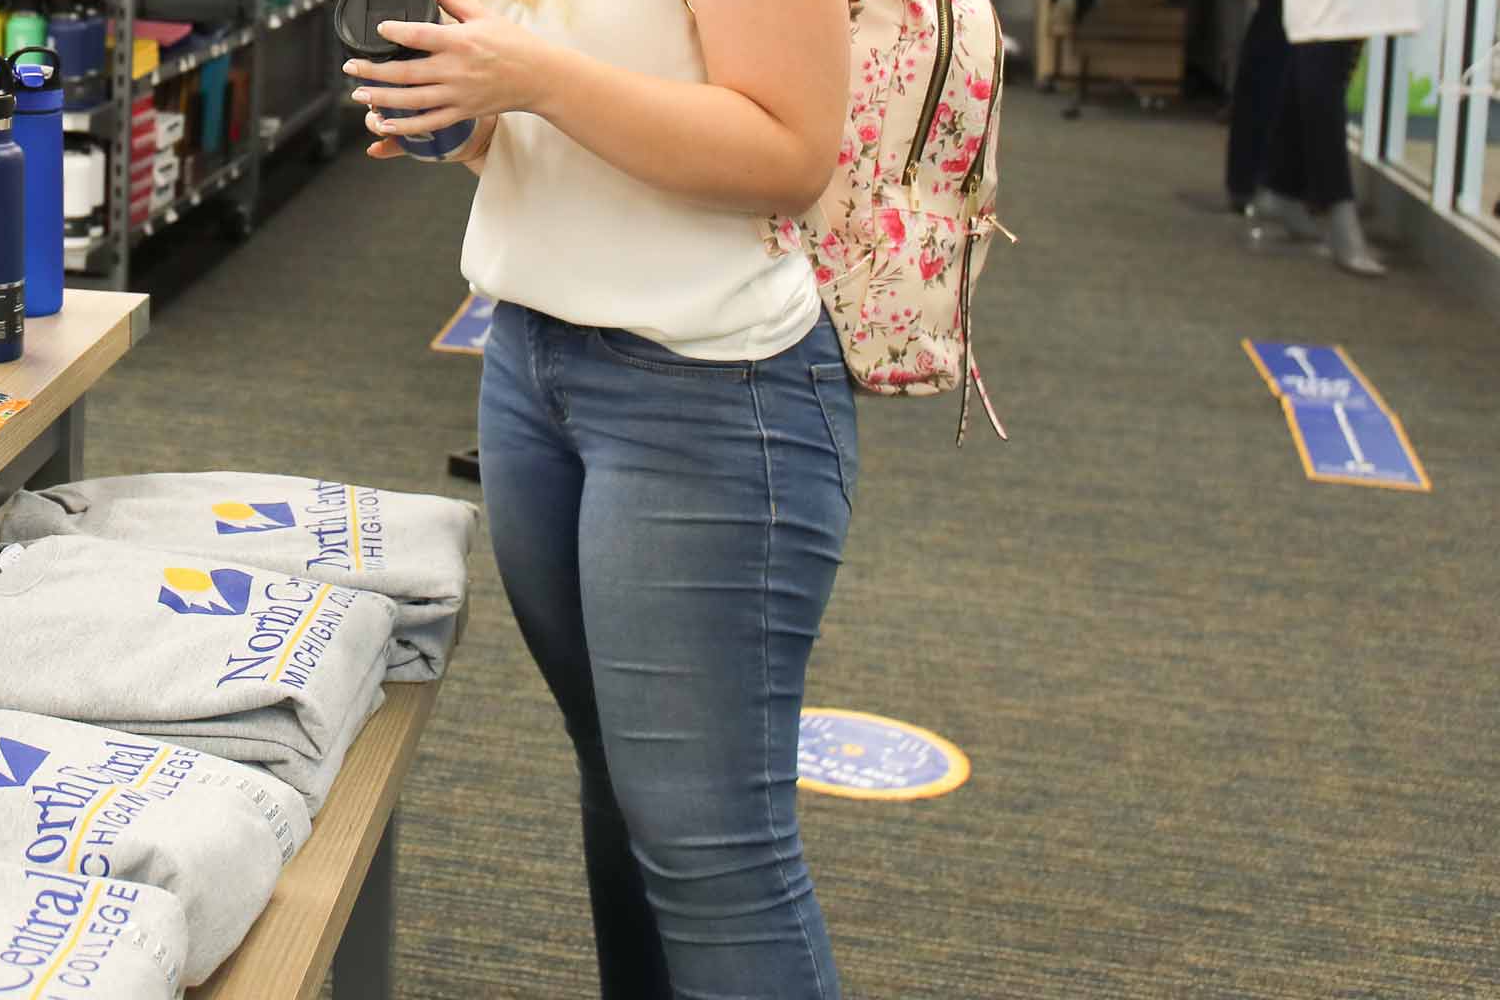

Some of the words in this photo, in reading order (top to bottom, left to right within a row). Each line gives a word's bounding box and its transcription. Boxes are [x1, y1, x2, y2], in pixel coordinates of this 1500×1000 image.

[216, 606, 303, 689] North
[280, 608, 344, 689] MICHIGAN
[25, 785, 99, 864] orth
[80, 789, 149, 878] CHIGAN
[58, 884, 139, 988] COLLEGE
